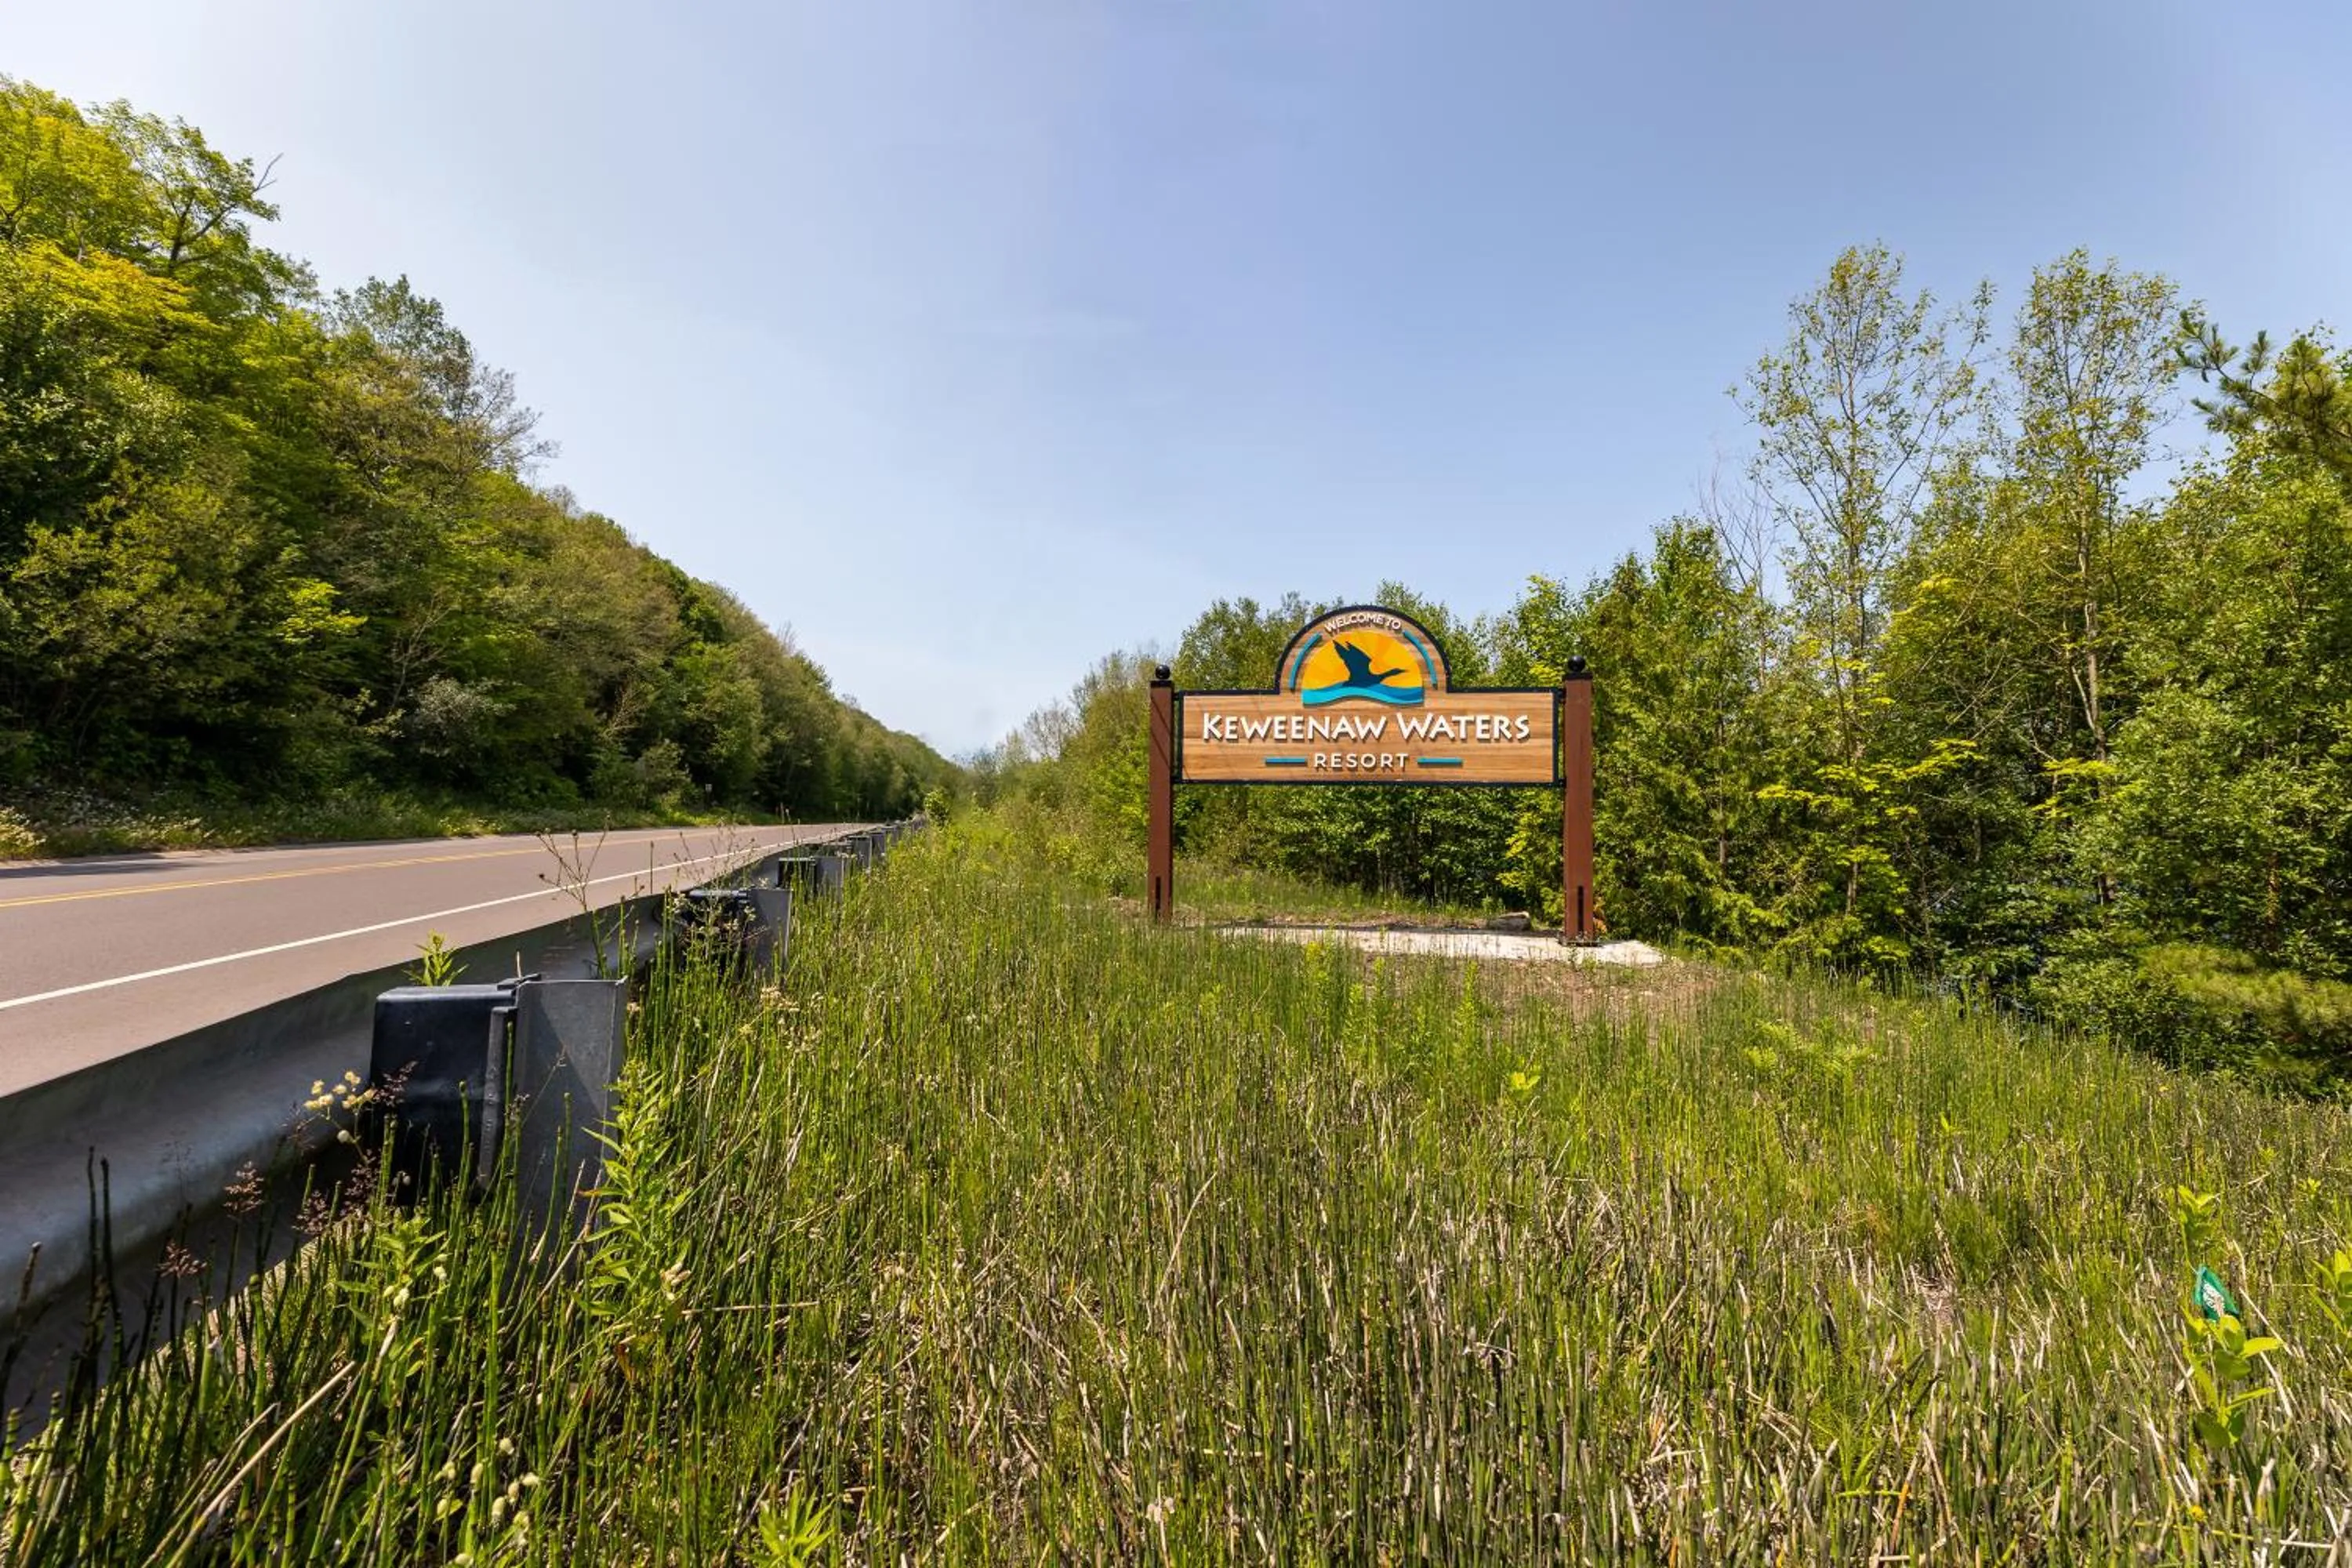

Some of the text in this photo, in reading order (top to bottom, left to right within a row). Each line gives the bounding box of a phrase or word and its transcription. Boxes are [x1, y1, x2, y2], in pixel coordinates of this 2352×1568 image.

[1324, 613, 1401, 632] WELCOME TO
[1203, 712, 1530, 740] KEWEENAW WATERS
[1314, 753, 1408, 768] RESORT
